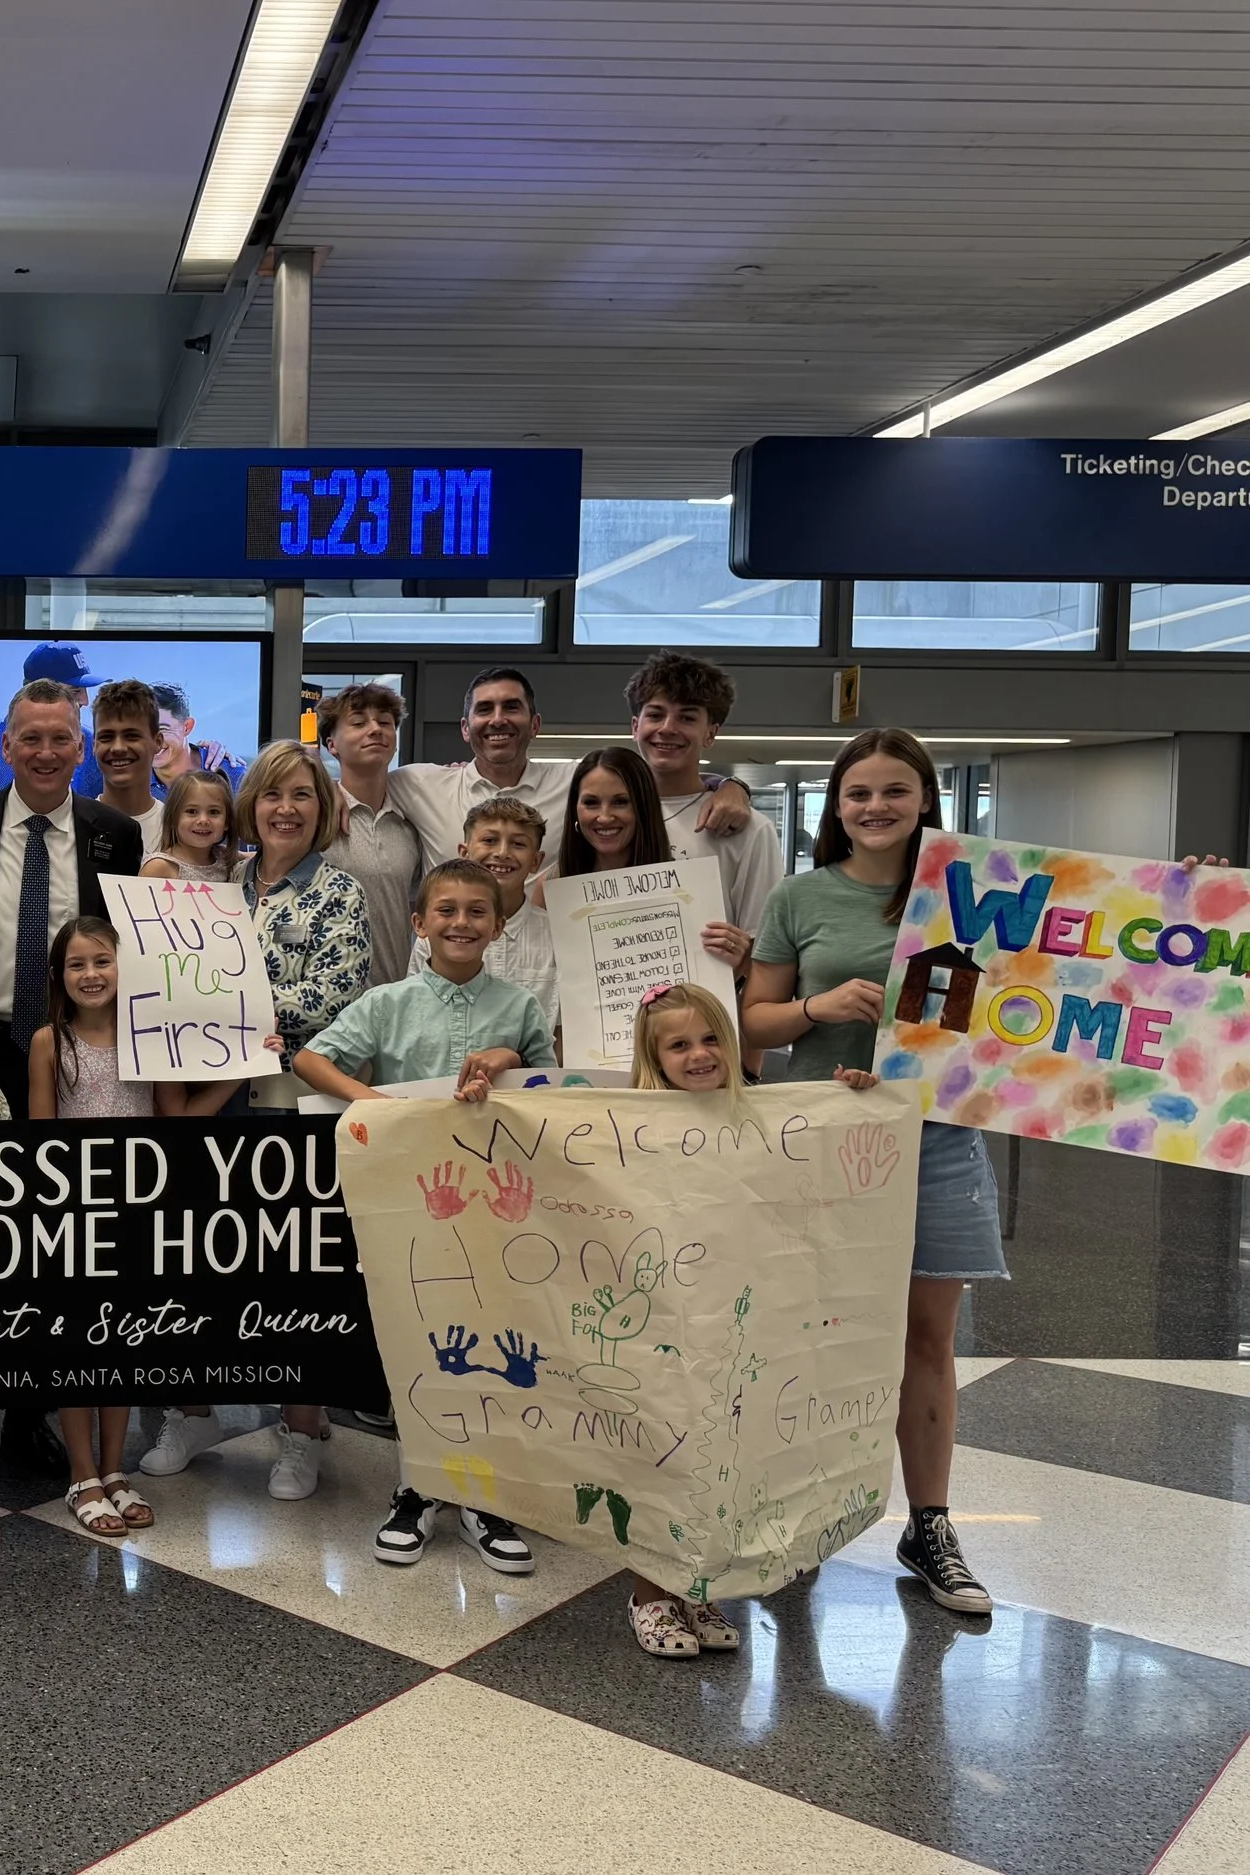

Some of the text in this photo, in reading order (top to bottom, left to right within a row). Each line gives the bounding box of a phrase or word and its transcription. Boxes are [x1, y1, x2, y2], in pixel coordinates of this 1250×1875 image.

[1163, 486, 1250, 510] Depart
[280, 468, 493, 555] 5:23 PM
[624, 869, 681, 897] WELCOME
[118, 883, 247, 977] Hug
[593, 917, 632, 932] COMPLETE
[944, 859, 1250, 978] WELCOM
[613, 929, 664, 949] RETURN HOME
[637, 949, 667, 962] ENDURE
[639, 965, 669, 977] FOLLOW
[605, 987, 626, 999] LOVE
[627, 984, 646, 994] WITH
[129, 989, 258, 1075] First
[452, 1108, 810, 1167] Welcome
[49, 1317, 66, 1336] &
[86, 1298, 212, 1346] Sister
[237, 1300, 359, 1341] Quinn
[50, 1367, 124, 1387] SANTA
[134, 1366, 196, 1385] ROSA
[204, 1364, 303, 1384] MISSION
[407, 1372, 690, 1468] Grammy
